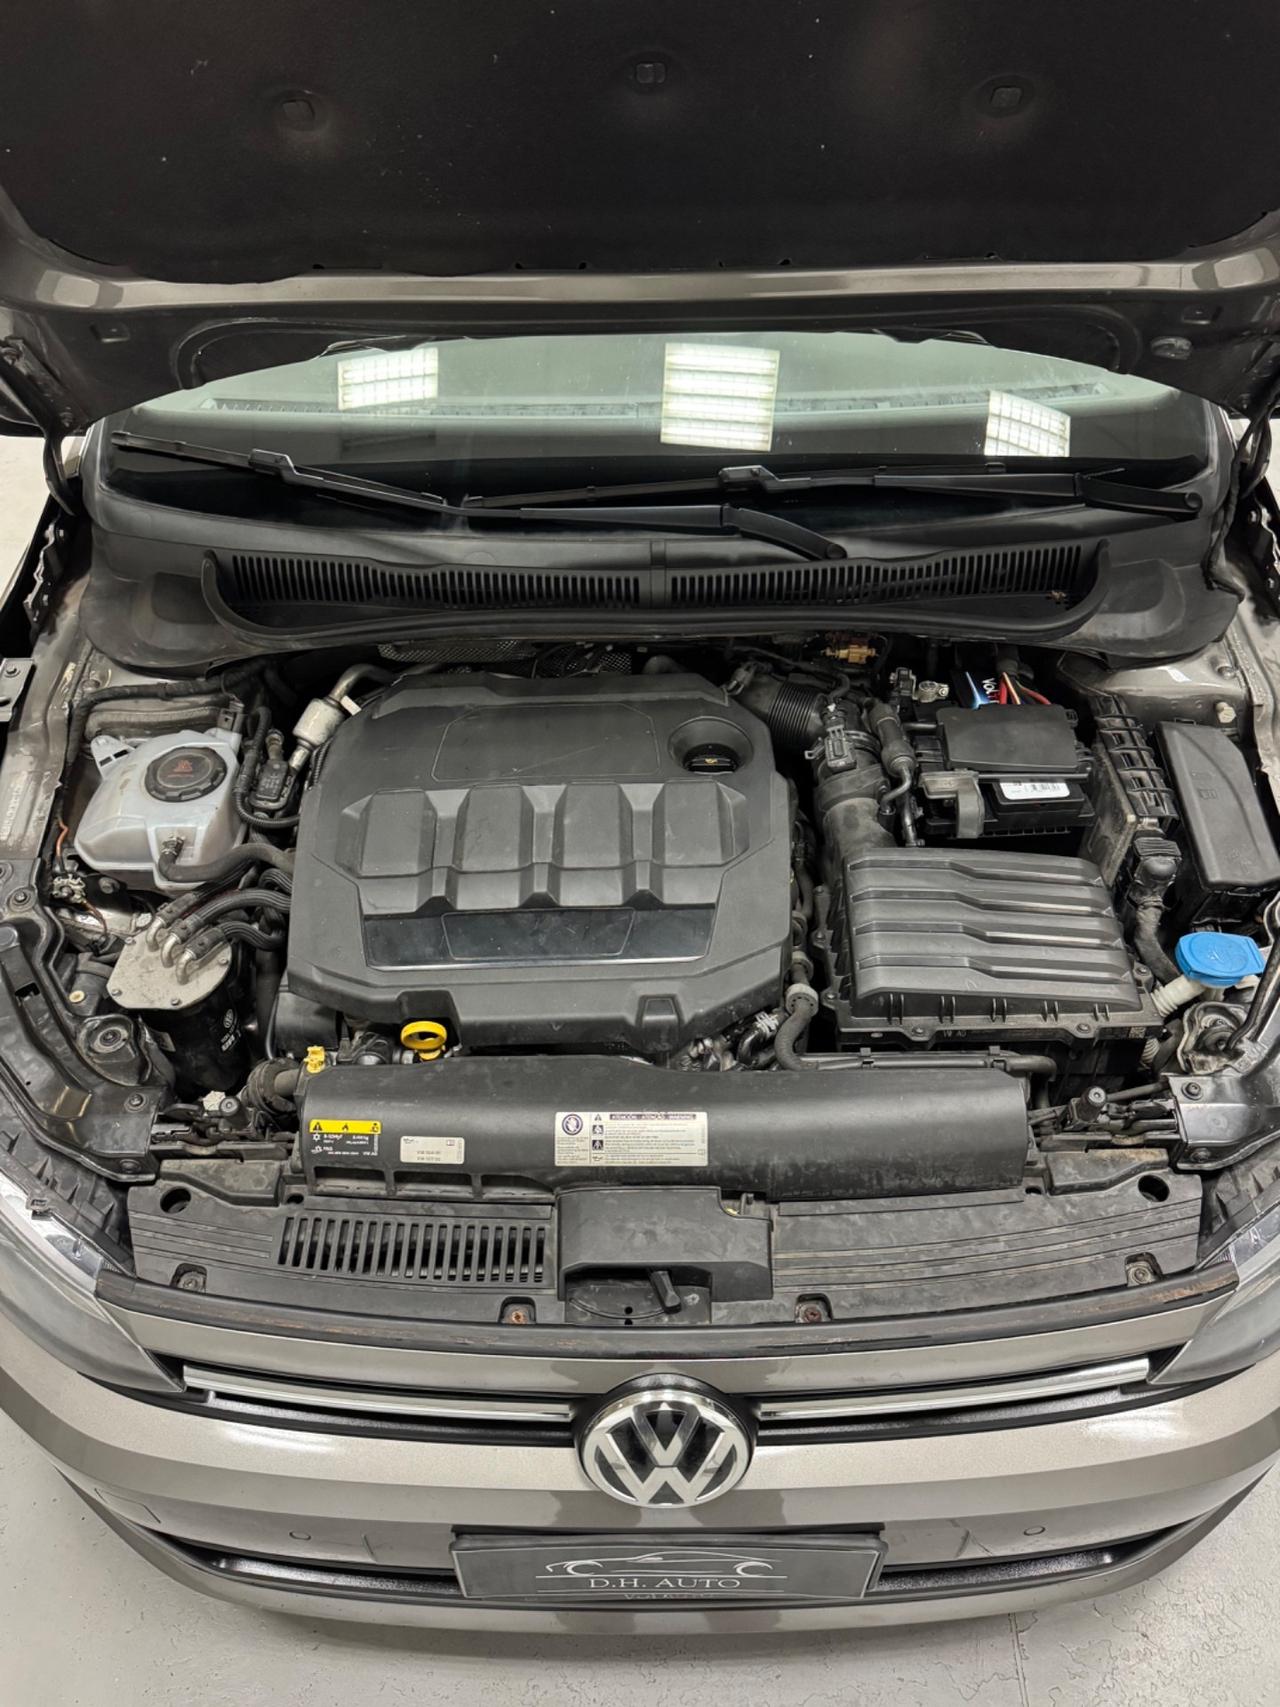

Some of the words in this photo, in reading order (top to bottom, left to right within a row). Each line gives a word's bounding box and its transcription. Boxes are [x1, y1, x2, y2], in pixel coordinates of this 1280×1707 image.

[591, 1395, 743, 1508] VW
[589, 1578, 647, 1589] D.H.
[655, 1577, 741, 1589] AUTO
